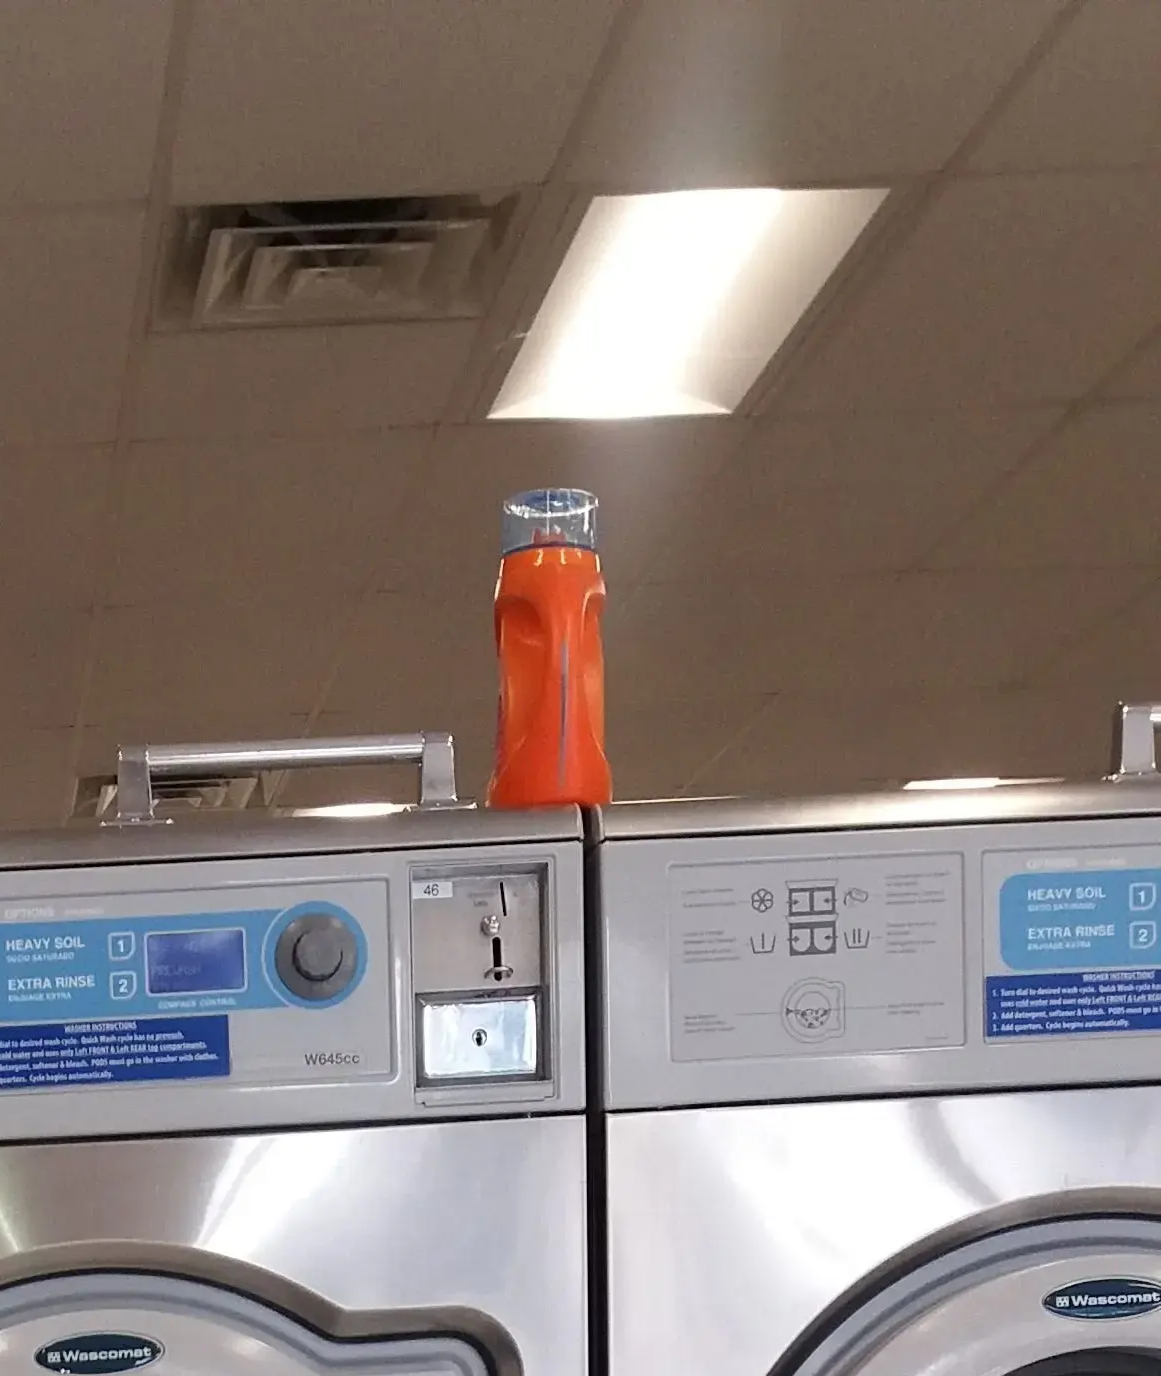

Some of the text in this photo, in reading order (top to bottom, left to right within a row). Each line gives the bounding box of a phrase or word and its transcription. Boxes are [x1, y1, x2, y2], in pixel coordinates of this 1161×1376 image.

[423, 884, 439, 896] 46
[1028, 887, 1106, 900] HEAVY SOIL
[1138, 890, 1145, 903] 1
[1028, 924, 1115, 939] EXTRA RINSE
[1138, 929, 1148, 942] 2
[6, 936, 85, 951] HEAVY SOIL
[117, 940, 124, 952] 1
[8, 975, 95, 990] EXTRA RINSE
[119, 979, 128, 992] 2
[304, 1051, 360, 1066] W645cc
[1071, 1291, 1161, 1306] Wascomat
[62, 1346, 152, 1362] Wascomat
